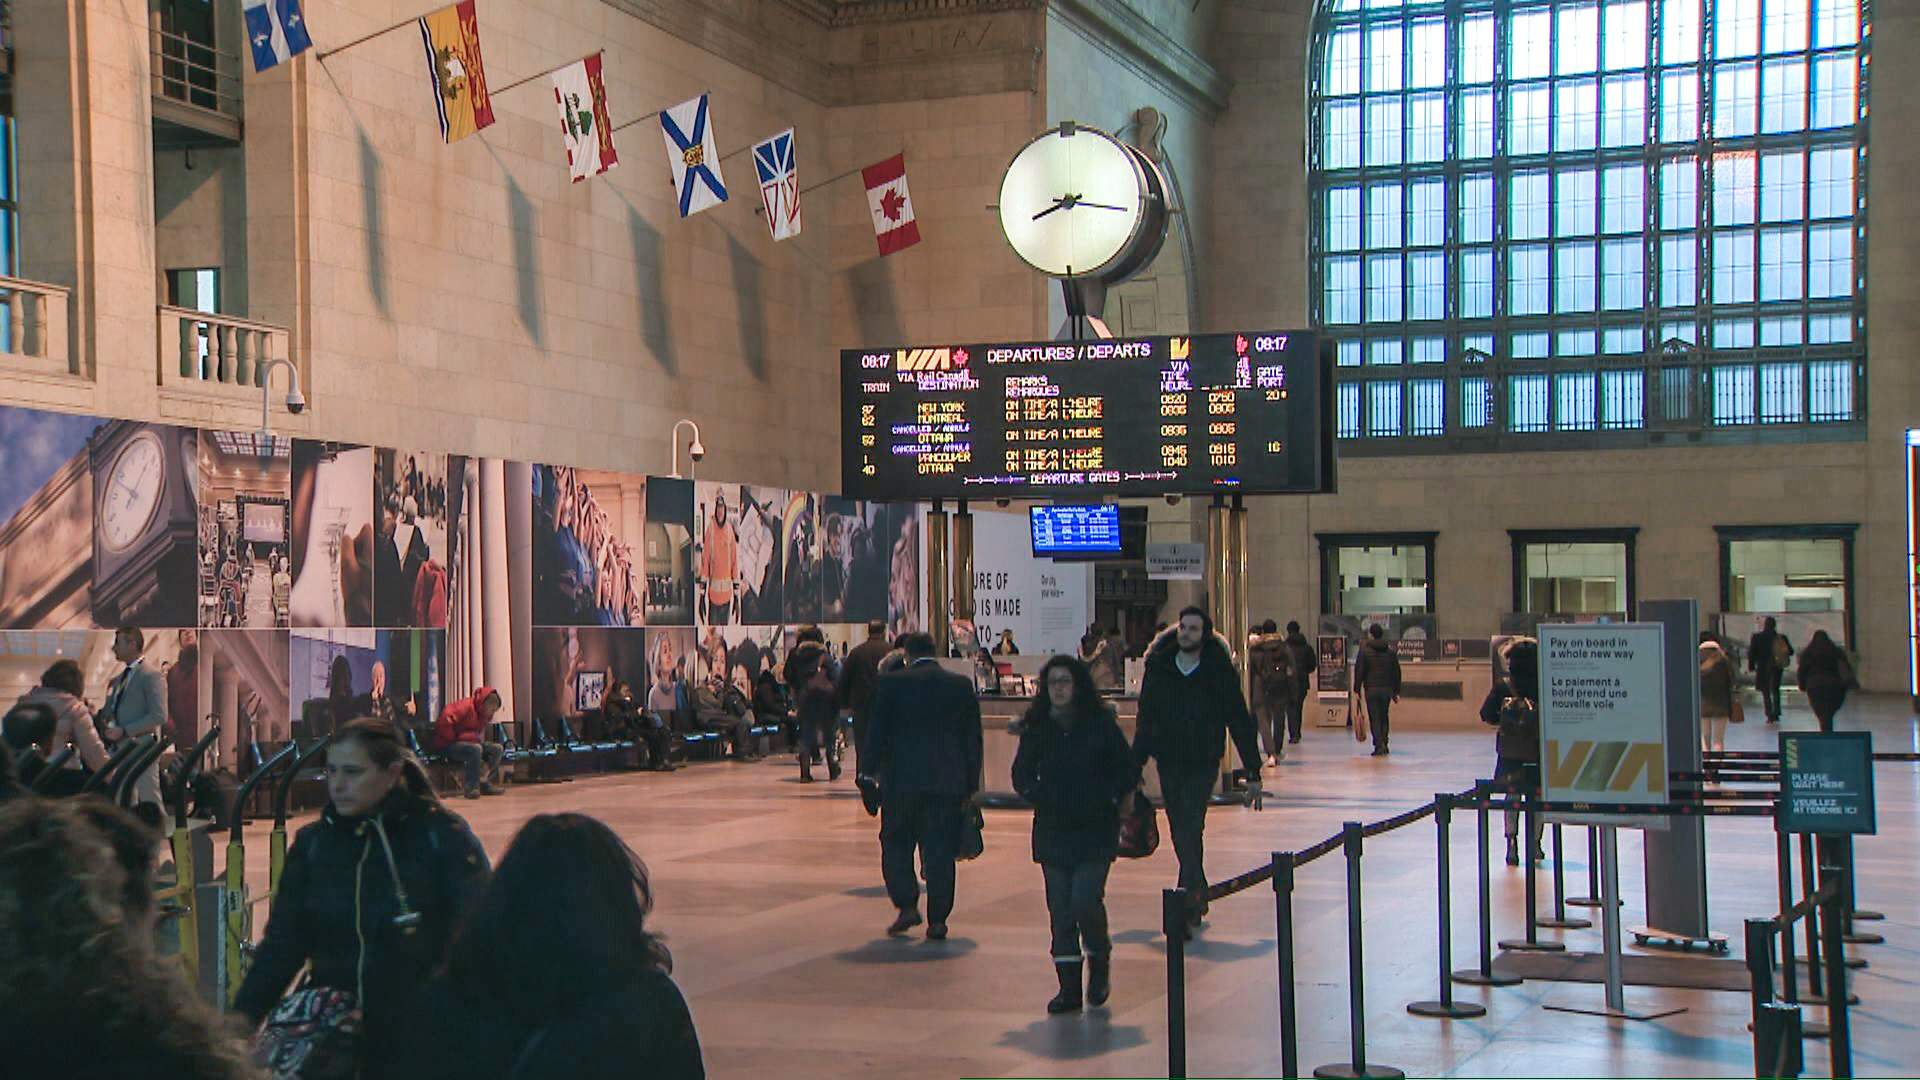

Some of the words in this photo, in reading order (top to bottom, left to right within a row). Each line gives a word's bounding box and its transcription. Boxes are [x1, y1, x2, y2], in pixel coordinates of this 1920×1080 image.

[1255, 336, 1287, 352] 08:17
[897, 348, 950, 370] VIA
[987, 347, 1075, 364] DEPARTURES
[1087, 343, 1151, 359] DEPARTS
[862, 353, 891, 368] 08:17
[1170, 361, 1190, 372] VIA
[1257, 365, 1283, 377] GATE
[897, 373, 915, 382] VIA
[917, 371, 935, 381] Rail
[936, 369, 970, 381] Canada
[1006, 375, 1048, 387] REMARKS
[1160, 371, 1185, 381] TIME
[862, 382, 890, 393] TRAIN
[918, 378, 980, 391] DESTINATION
[1257, 376, 1283, 388] PORT
[1006, 386, 1060, 398] REMARQUES
[1266, 390, 1280, 401] 20
[918, 403, 937, 413] NEW
[940, 402, 965, 412] YORK
[1006, 400, 1019, 410] ON
[918, 413, 965, 424] MONTREAL
[1006, 411, 1019, 421] ON
[918, 433, 954, 444] OTTAWA
[1006, 430, 1019, 441] ON
[918, 452, 972, 463] VANCOUVER
[1006, 450, 1019, 461] ON
[1211, 455, 1236, 466] 1010
[918, 463, 954, 474] OTTAWA
[1006, 461, 1019, 472] ON
[1030, 473, 1084, 485] DEPARTURE
[1088, 471, 1120, 483] GATES
[996, 573, 1008, 590] OF
[981, 599, 991, 616] IS
[995, 599, 1021, 616] MADE
[1550, 637, 1567, 648] Pay
[1571, 639, 1583, 647] on
[1586, 637, 1615, 648] board
[1618, 637, 1628, 647] in
[1558, 649, 1588, 658] whole
[1590, 650, 1612, 658] new
[1614, 650, 1634, 660] way
[1552, 677, 1563, 686] Le
[1565, 676, 1611, 689] paiement
[1552, 688, 1574, 697] bord
[1576, 688, 1606, 699] prend
[1609, 689, 1628, 698] une
[1552, 699, 1591, 709] nouvelle
[1593, 699, 1615, 709] voie
[1545, 740, 1665, 793] VIA
[1793, 806, 1842, 814] ATTENDRE
